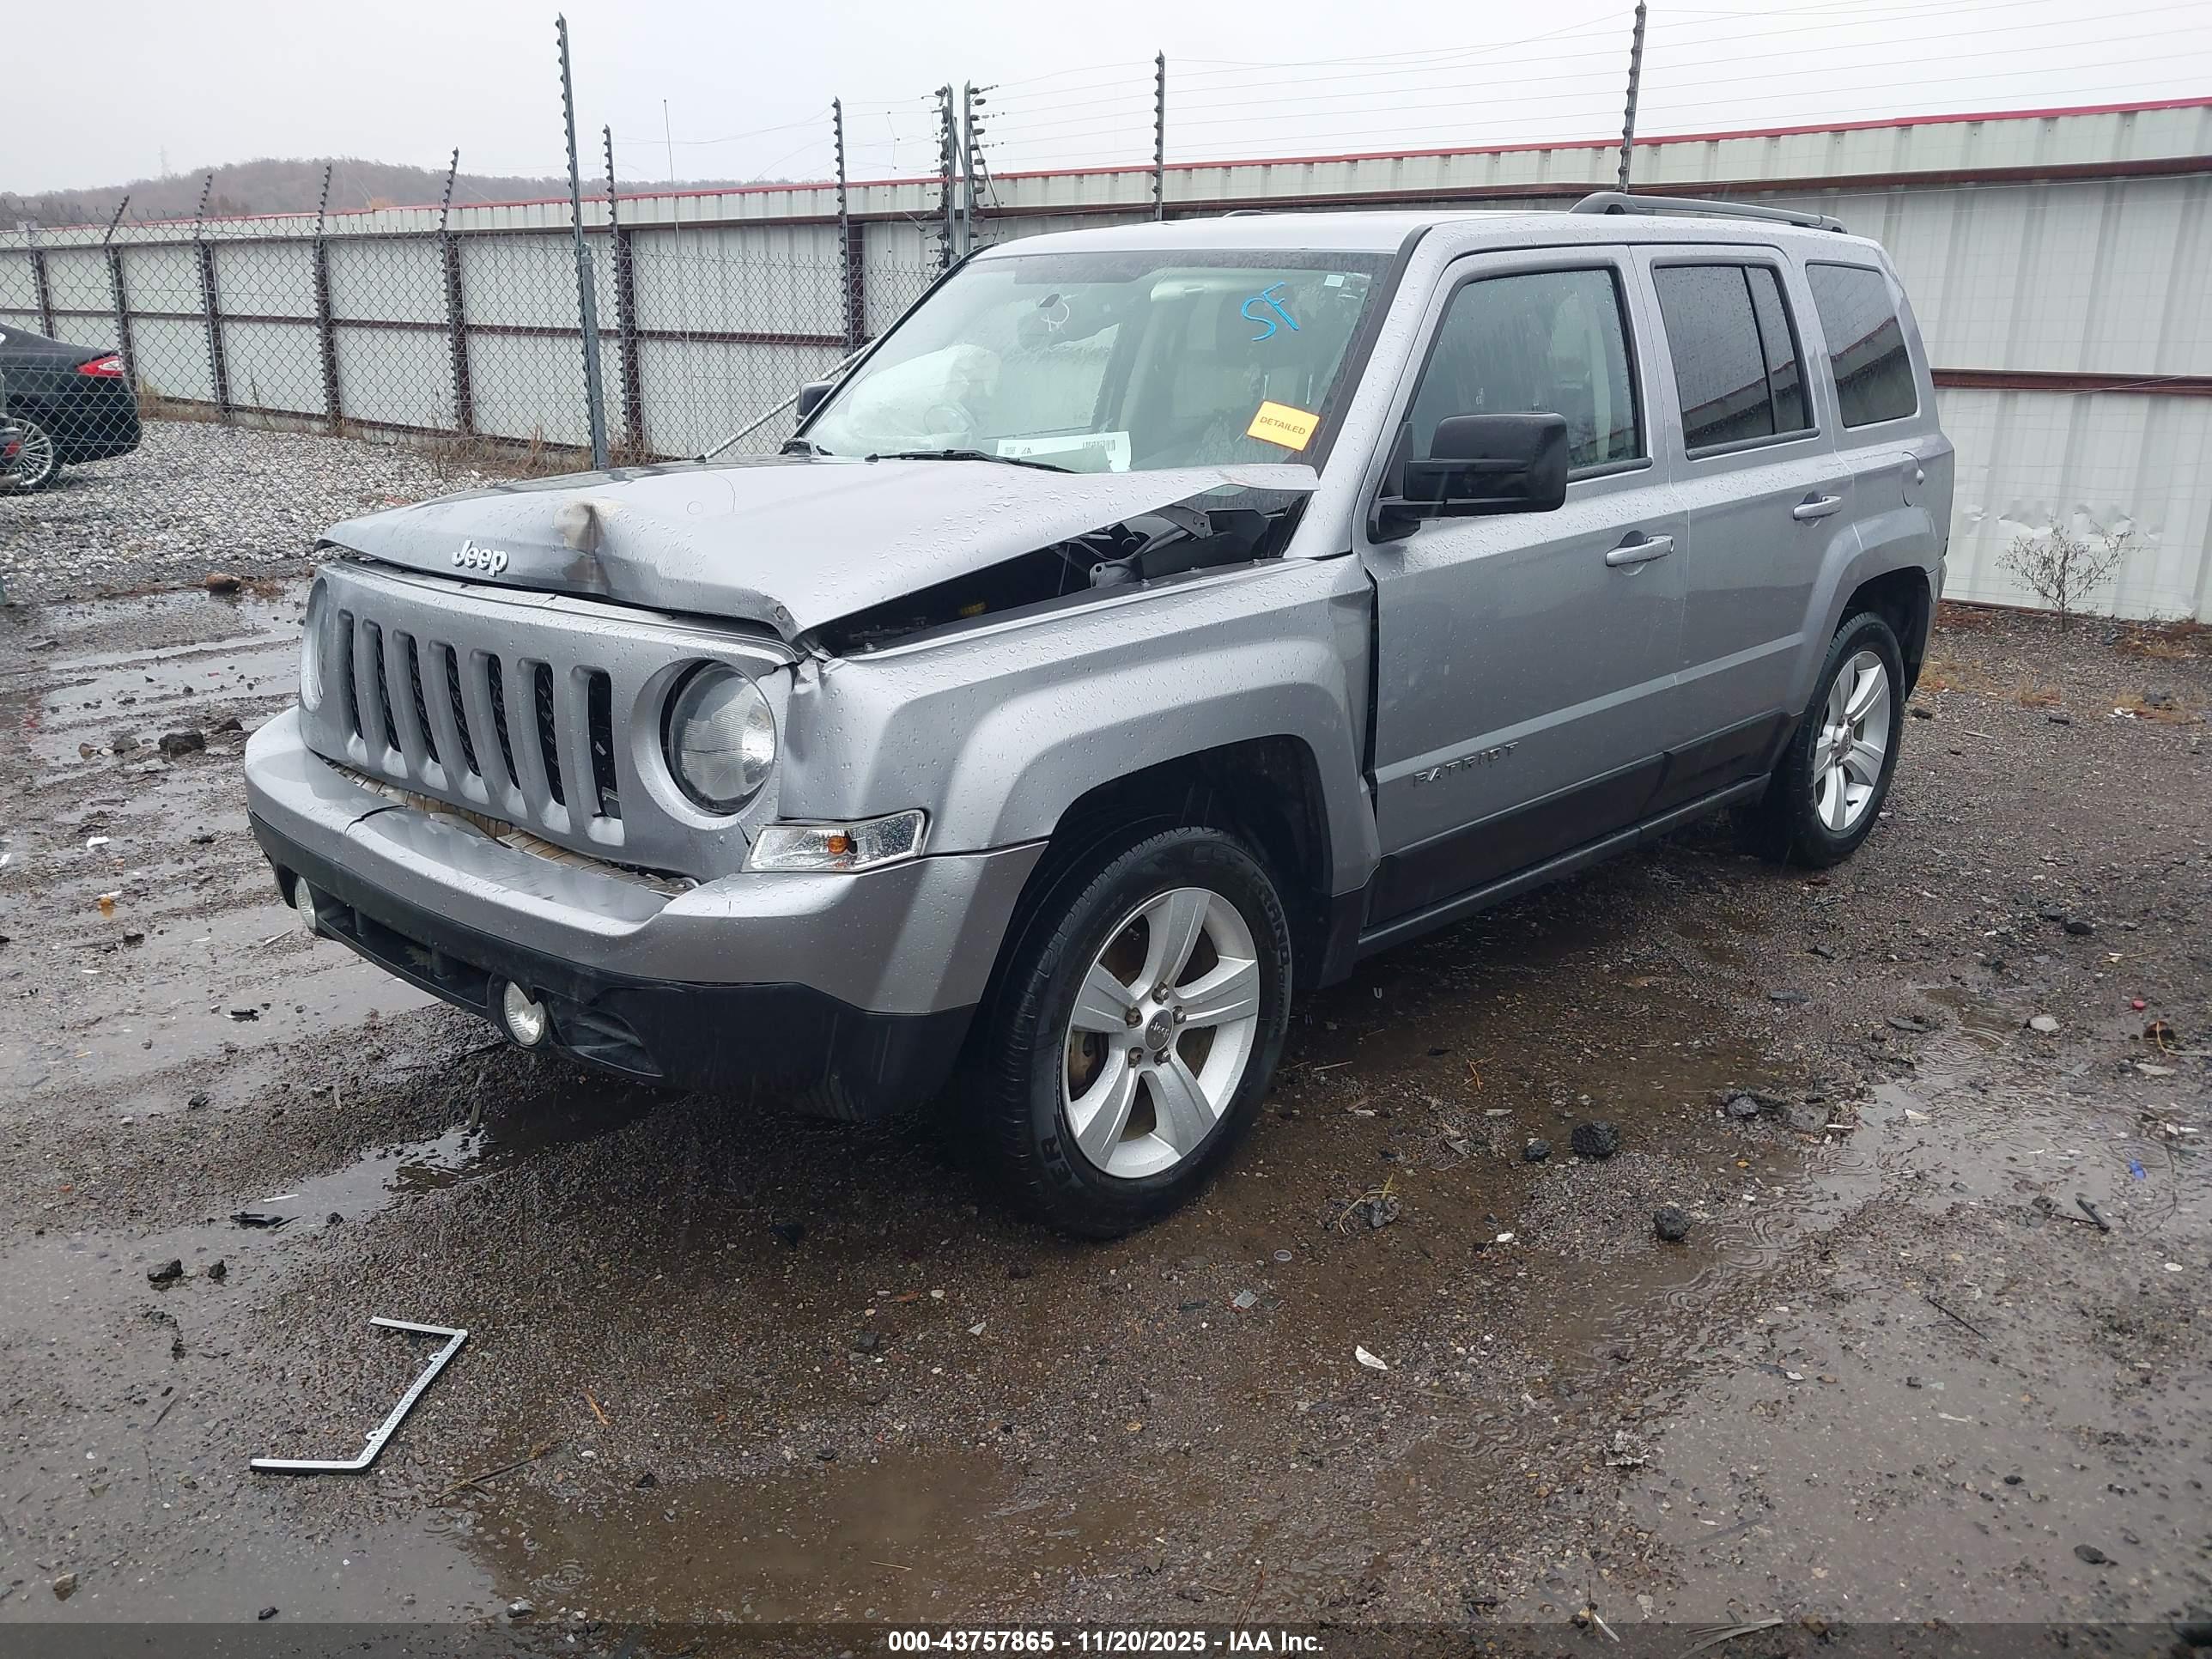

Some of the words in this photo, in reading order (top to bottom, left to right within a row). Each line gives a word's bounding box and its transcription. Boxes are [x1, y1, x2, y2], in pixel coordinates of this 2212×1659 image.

[1259, 416, 1306, 434] DETAILED
[451, 539, 509, 578] Jeep
[1413, 741, 1519, 787] PATRIOT
[360, 1439, 383, 1462] DON
[379, 1379, 427, 1437] THORNTON
[424, 1333, 465, 1380] CADILLAC
